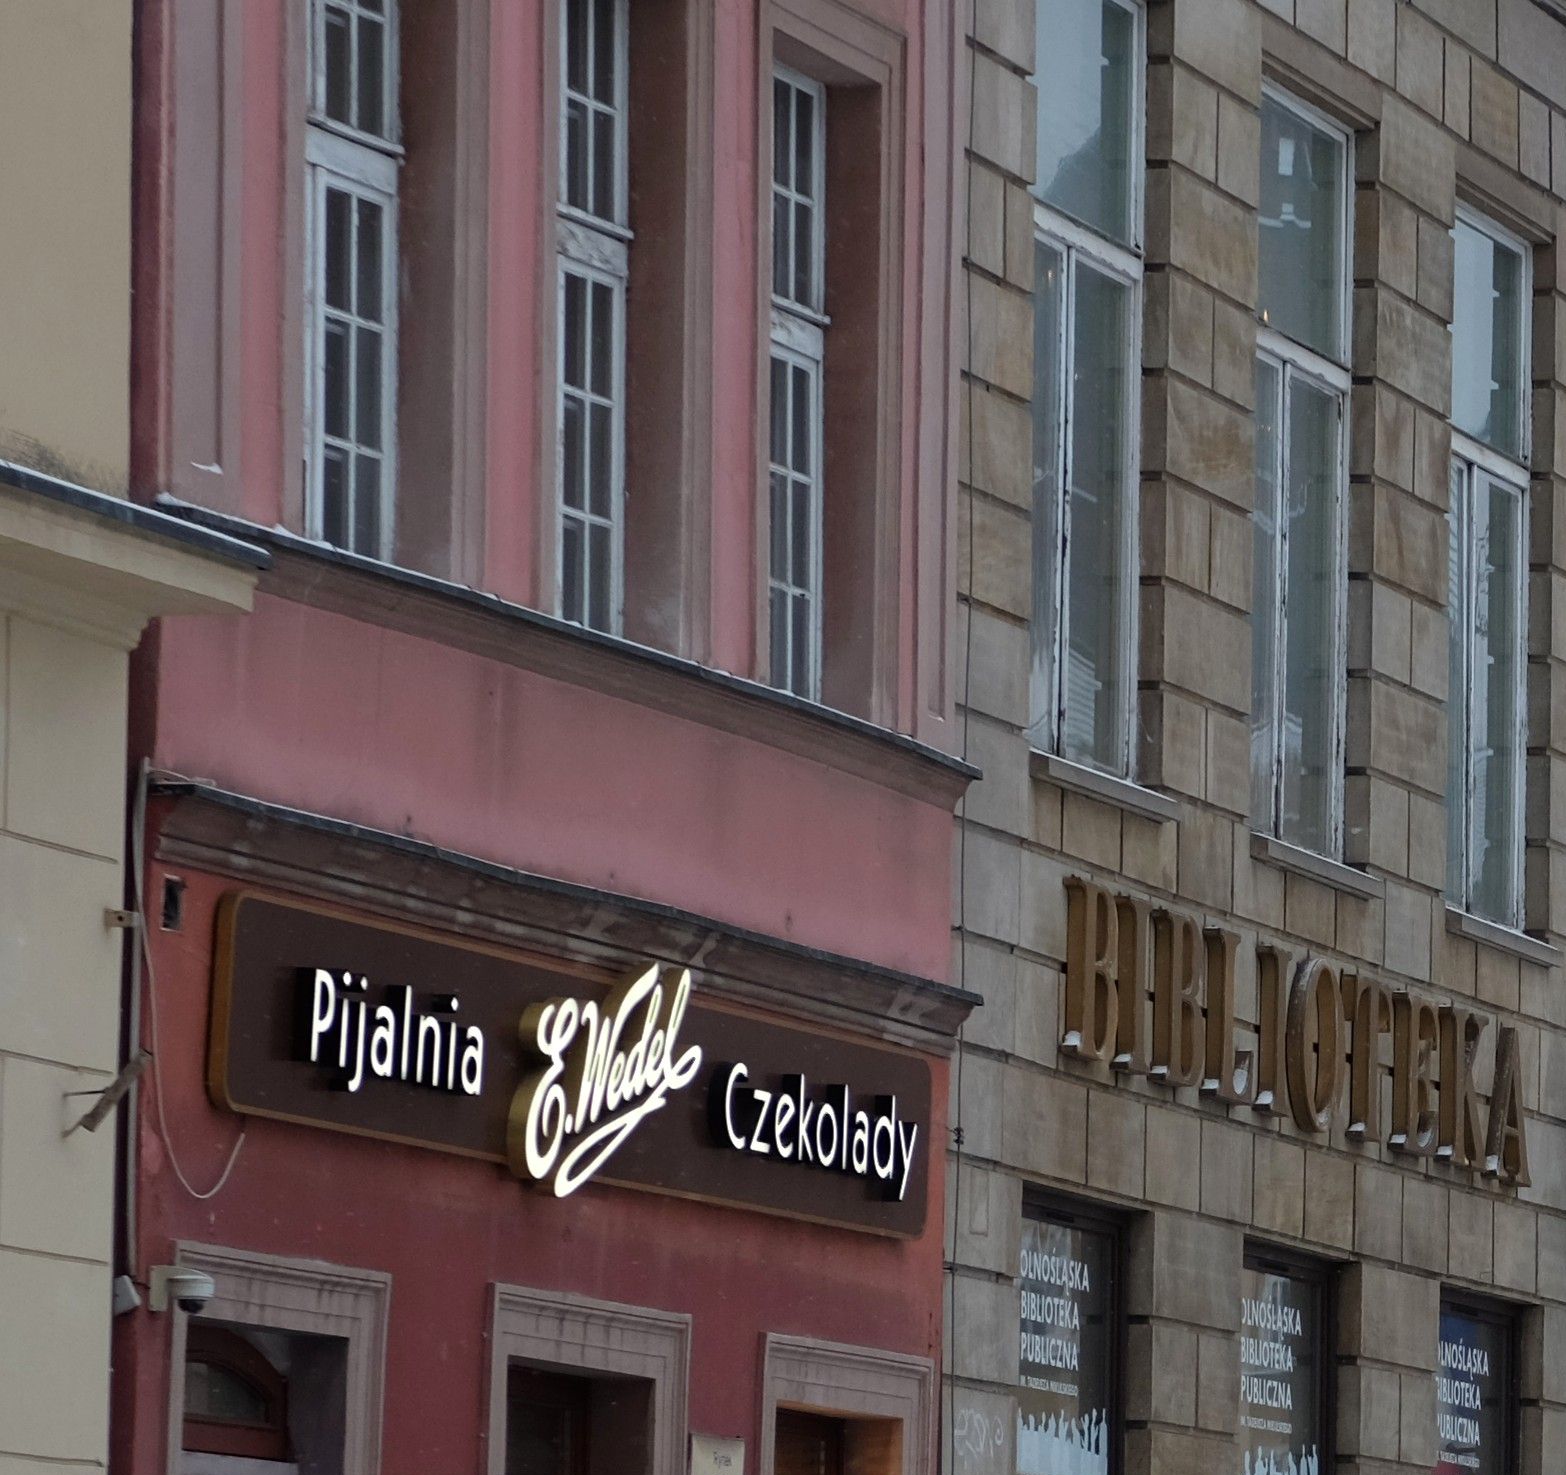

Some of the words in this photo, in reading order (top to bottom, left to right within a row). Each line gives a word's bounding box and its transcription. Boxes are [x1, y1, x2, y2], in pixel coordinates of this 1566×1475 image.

[1060, 875, 1532, 1187] BIBLIOTEKA
[310, 968, 484, 1096] Pijalnia
[725, 1062, 918, 1200] Czekolady
[1020, 1290, 1080, 1331] BIBLIOTEKA
[1020, 1332, 1079, 1372] PUBLICZNA
[1240, 1337, 1293, 1372] BIBLIOTEKA
[1438, 1338, 1489, 1380] LNOŚLĄSKA
[1240, 1375, 1292, 1410] PUBLICZNA
[1438, 1413, 1480, 1446] UBLICZNA
